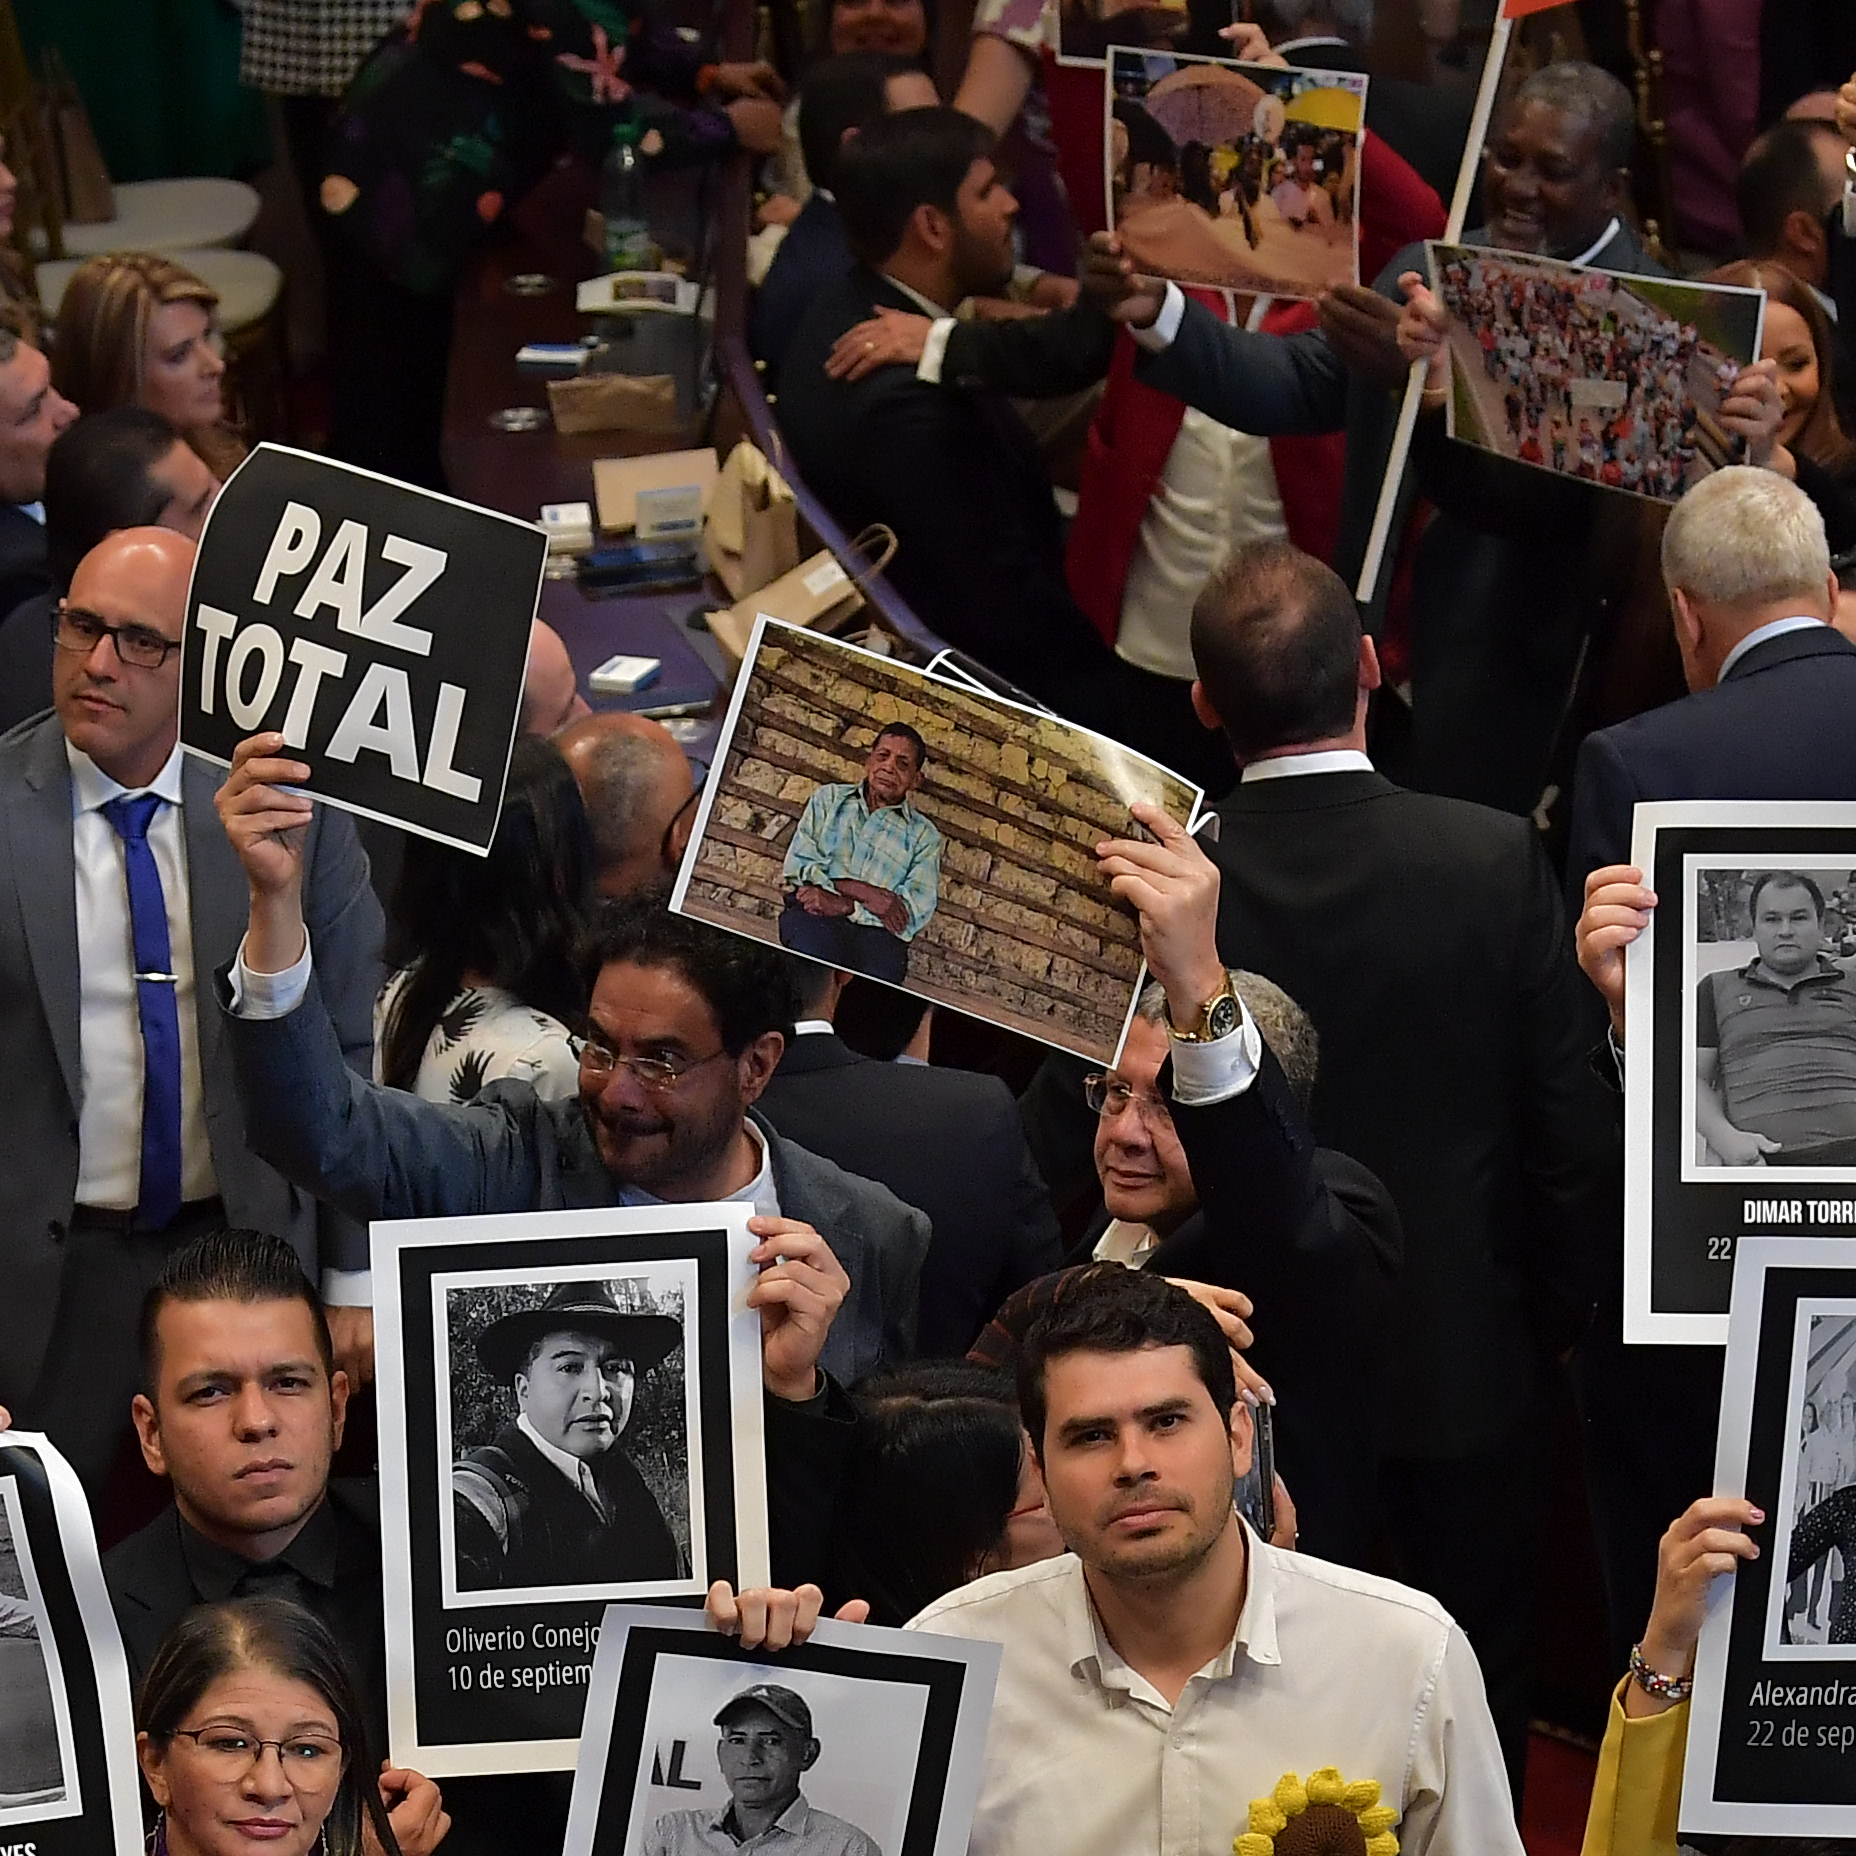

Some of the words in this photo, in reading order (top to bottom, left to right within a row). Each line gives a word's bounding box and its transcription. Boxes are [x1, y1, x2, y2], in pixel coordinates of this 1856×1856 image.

[252, 500, 448, 657] PAZ
[196, 603, 483, 804] TOTAL
[1744, 1200, 1803, 1223] DIMAR
[1707, 1237, 1732, 1260] 22
[446, 1625, 525, 1653] Oliverio
[532, 1621, 602, 1653] Conejo
[448, 1665, 472, 1690] 10
[479, 1663, 505, 1689] de
[511, 1660, 593, 1694] septiem
[1747, 1720, 1774, 1747] 22
[1781, 1719, 1810, 1747] de
